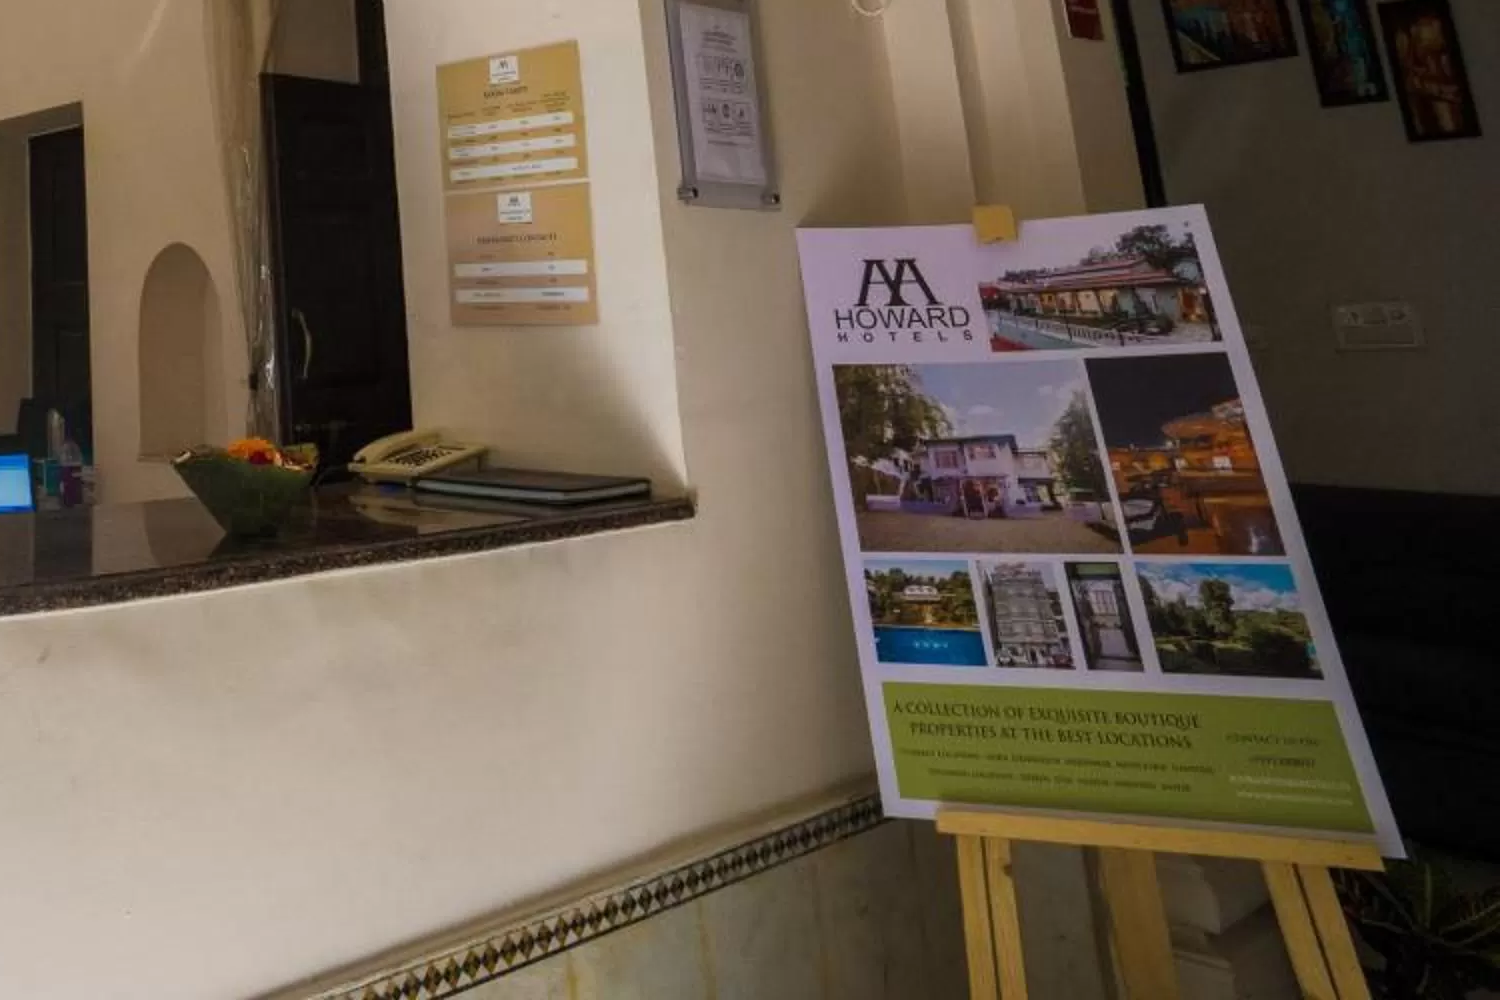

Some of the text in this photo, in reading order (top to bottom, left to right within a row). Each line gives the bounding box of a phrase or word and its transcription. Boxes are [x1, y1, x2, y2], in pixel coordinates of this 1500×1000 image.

[834, 306, 970, 330] HOWARD
[837, 329, 973, 343] HOTELS
[894, 700, 1202, 731] A COLLECTION OF EXQUISITE BOUTIQUE
[910, 721, 1193, 749] PROPERTIES AT THE BEST LOCATIONS
